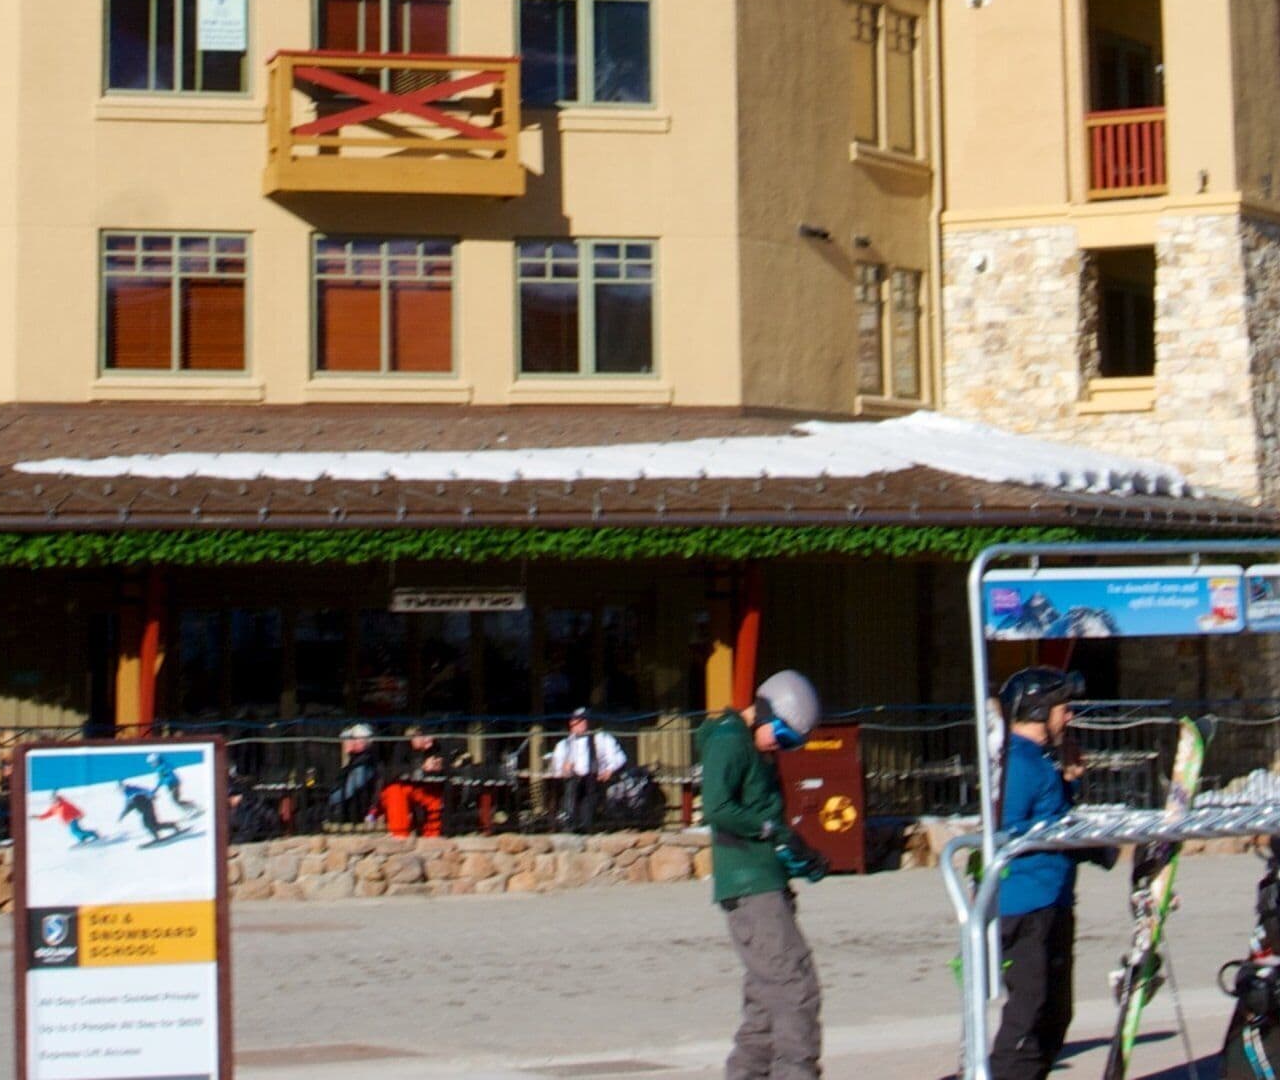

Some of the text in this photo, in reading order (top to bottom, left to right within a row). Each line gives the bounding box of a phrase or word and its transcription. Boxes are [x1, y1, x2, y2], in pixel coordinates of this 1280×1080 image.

[89, 913, 117, 926] SKI
[88, 926, 198, 942] SNOWBOARD
[88, 943, 159, 958] SCHOOL
